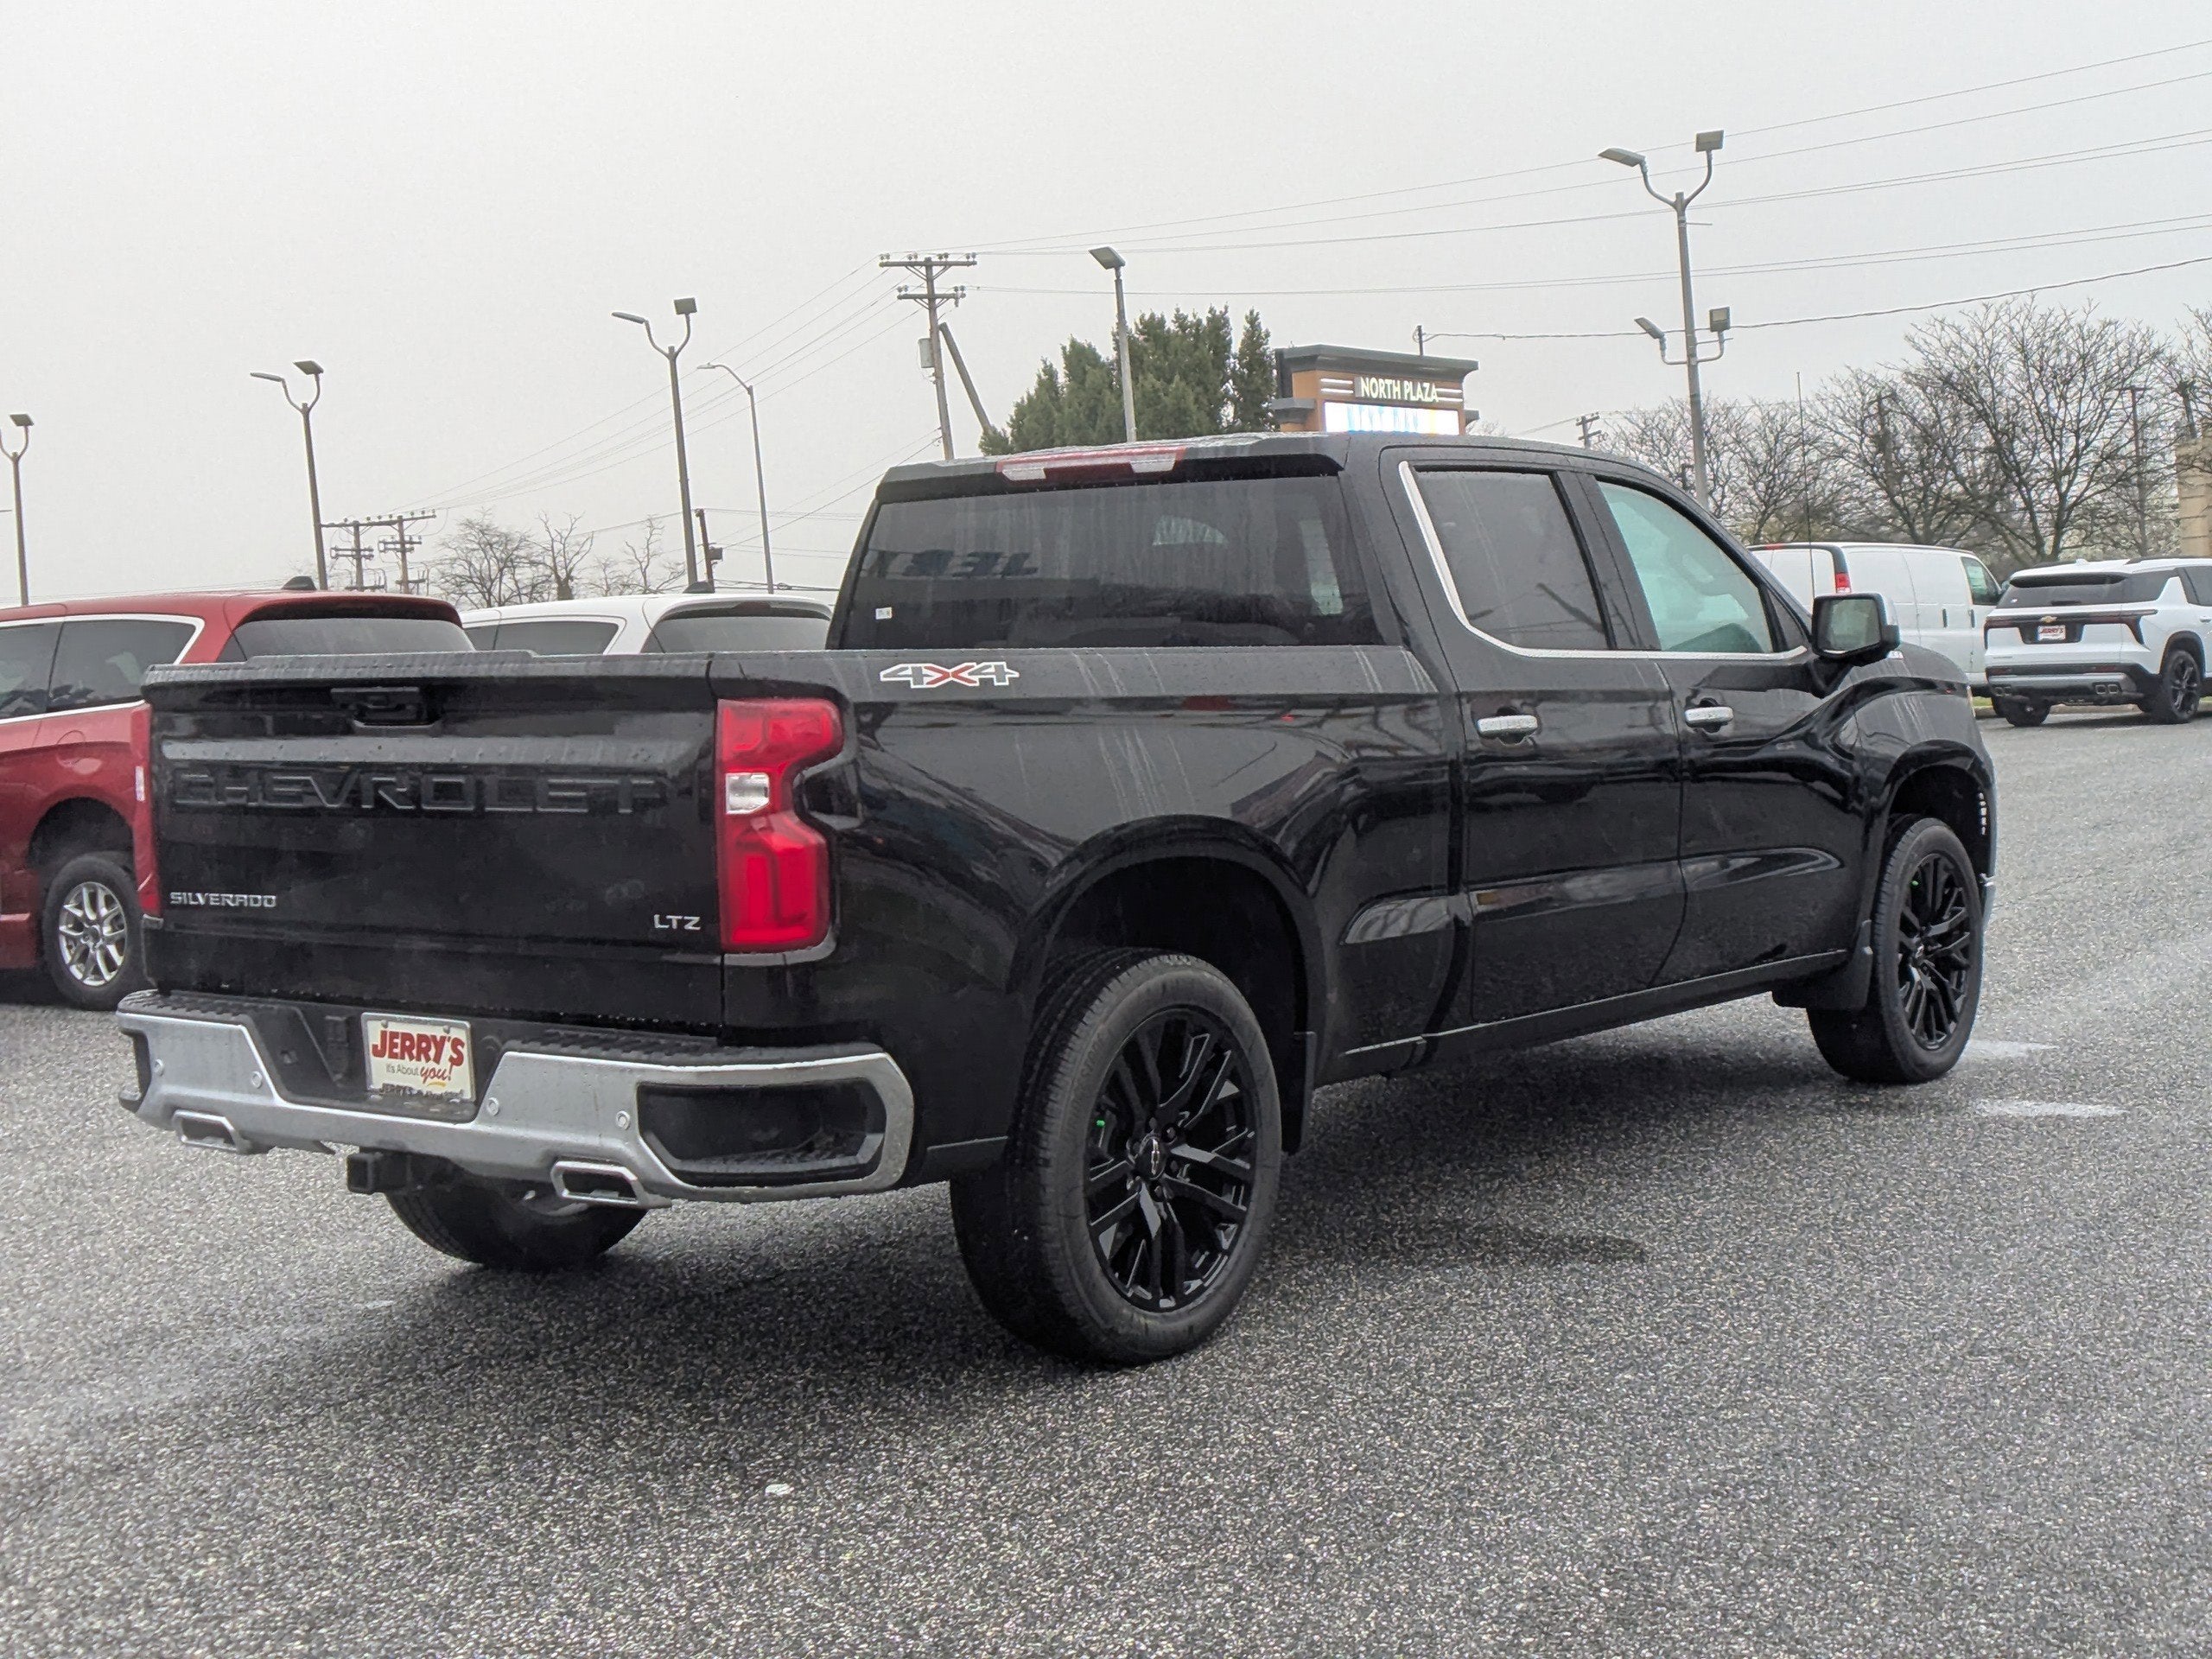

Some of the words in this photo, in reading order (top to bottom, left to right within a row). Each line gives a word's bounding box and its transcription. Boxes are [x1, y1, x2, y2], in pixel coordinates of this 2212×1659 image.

[1360, 377, 1401, 399] NORTH
[1403, 380, 1439, 402] PLAZA
[175, 771, 660, 813] CHEVROLET
[170, 892, 276, 907] SILVERADO
[654, 914, 701, 930] LTZ
[372, 1030, 465, 1066] JERRY'S
[397, 1064, 419, 1076] About
[420, 1063, 452, 1084] you!
